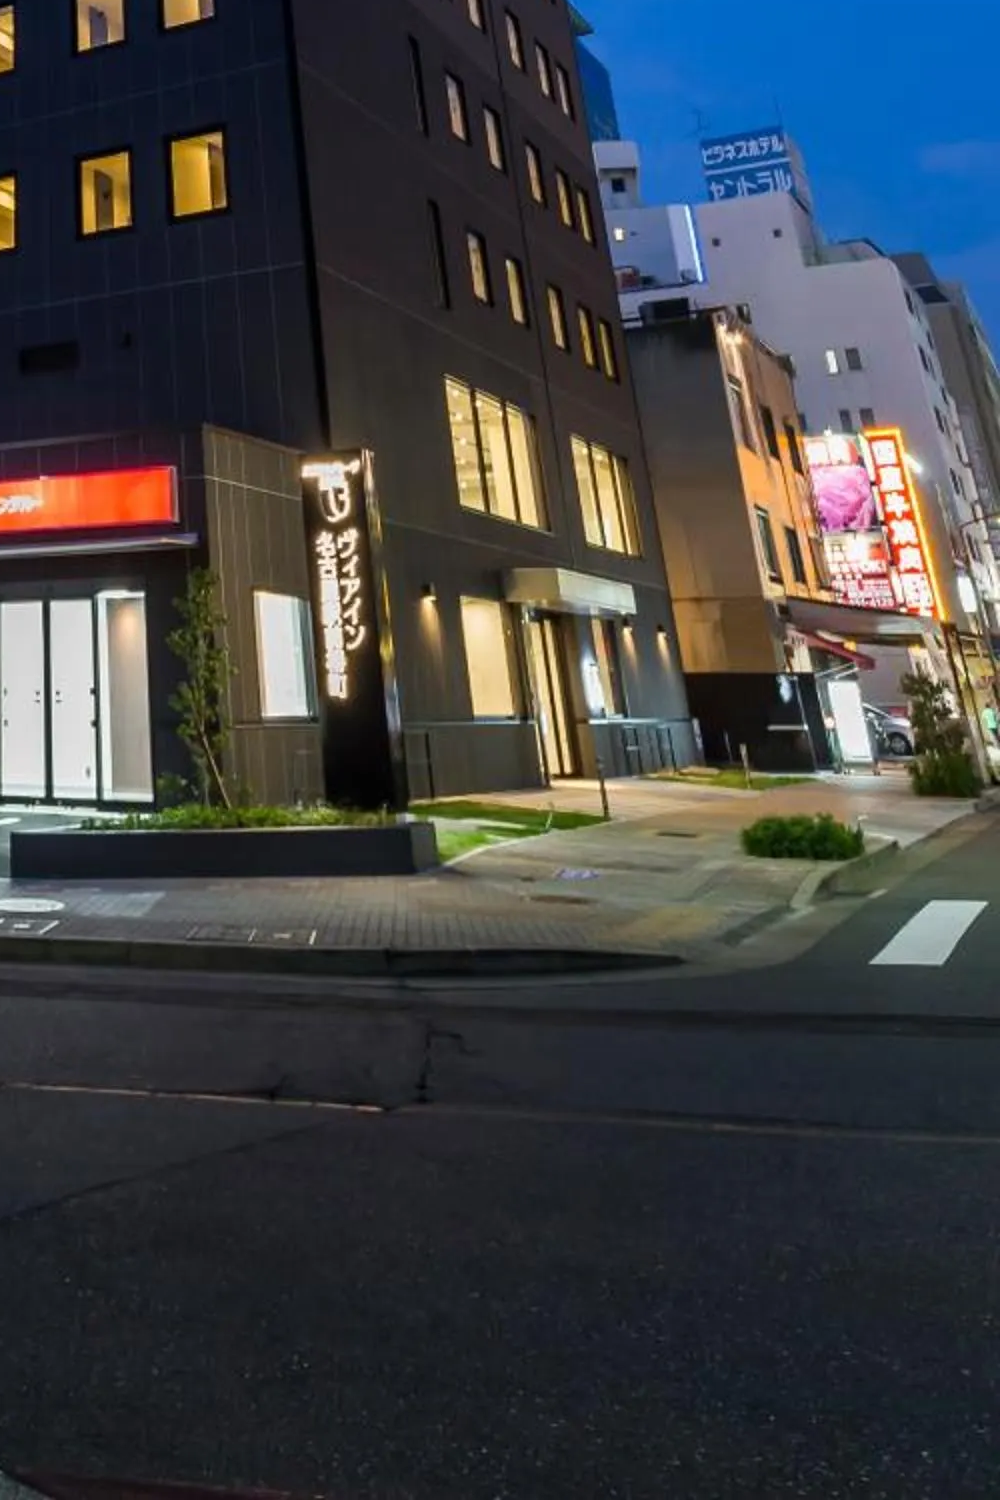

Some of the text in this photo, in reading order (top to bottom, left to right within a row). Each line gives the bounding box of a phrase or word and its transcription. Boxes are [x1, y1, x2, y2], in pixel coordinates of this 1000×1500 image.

[702, 134, 784, 165] ビジネスホテル
[710, 167, 792, 200] セントラル
[337, 528, 365, 650] ヴィアイン
